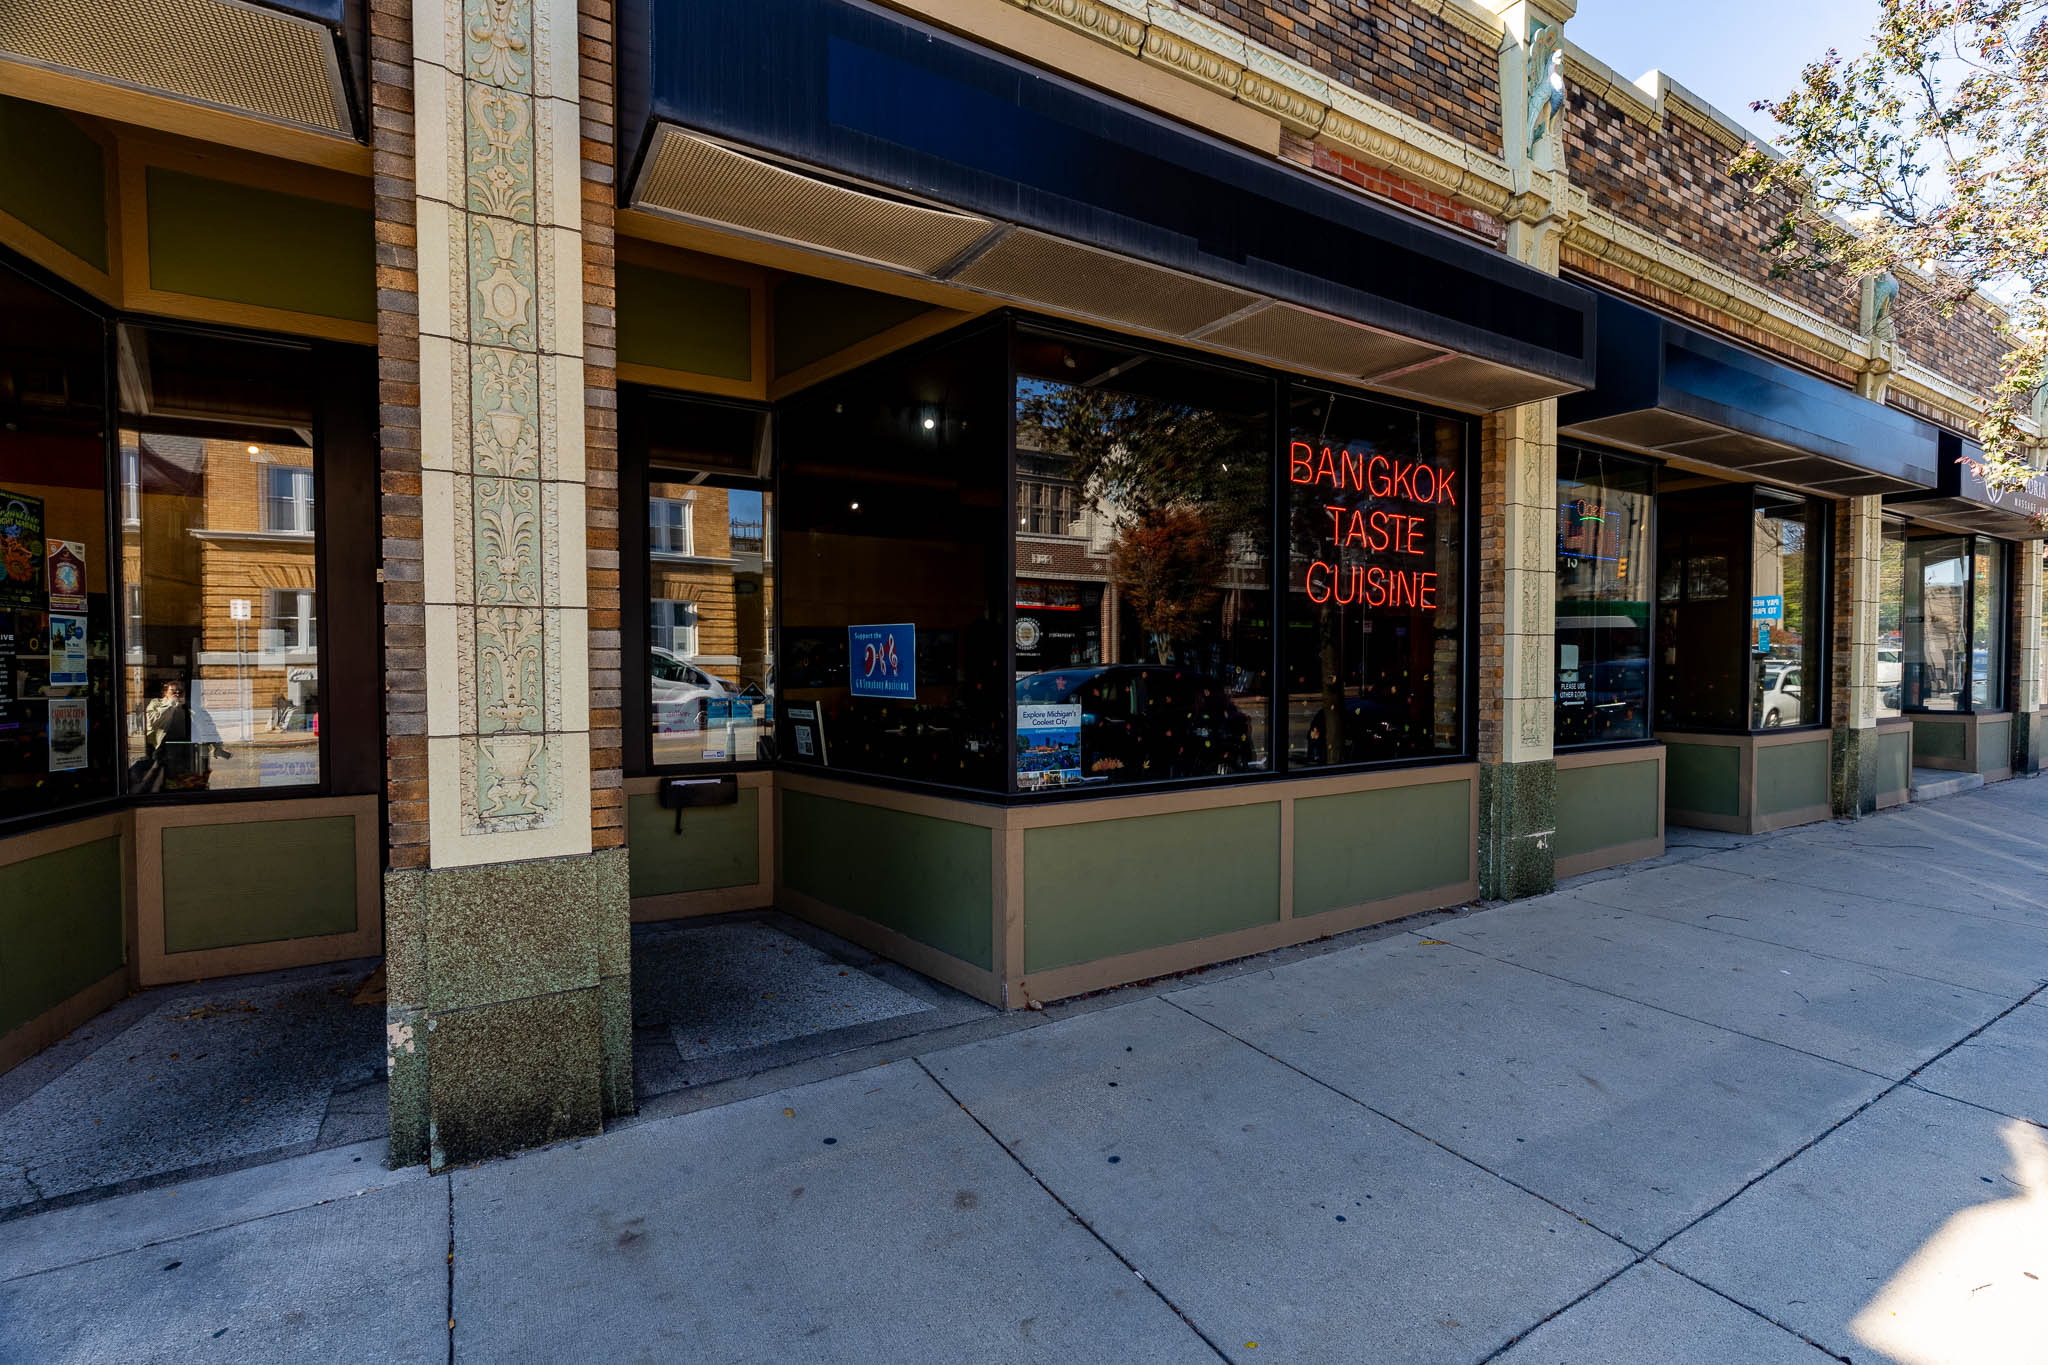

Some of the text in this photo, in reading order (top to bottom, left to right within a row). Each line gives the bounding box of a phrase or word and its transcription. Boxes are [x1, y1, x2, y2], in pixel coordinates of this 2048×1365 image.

[1290, 441, 1456, 507] BANGKOK
[1576, 499, 1606, 518] Open
[2014, 498, 2036, 512] MASSAGE
[1325, 505, 1425, 555] TASTE
[1306, 560, 1438, 609] CUISINE
[854, 632, 873, 641] Support
[1577, 682, 1586, 690] USE
[1559, 691, 1574, 699] OTHER
[1023, 710, 1076, 719] Explore Michigan's
[1032, 718, 1068, 726] Coolest City
